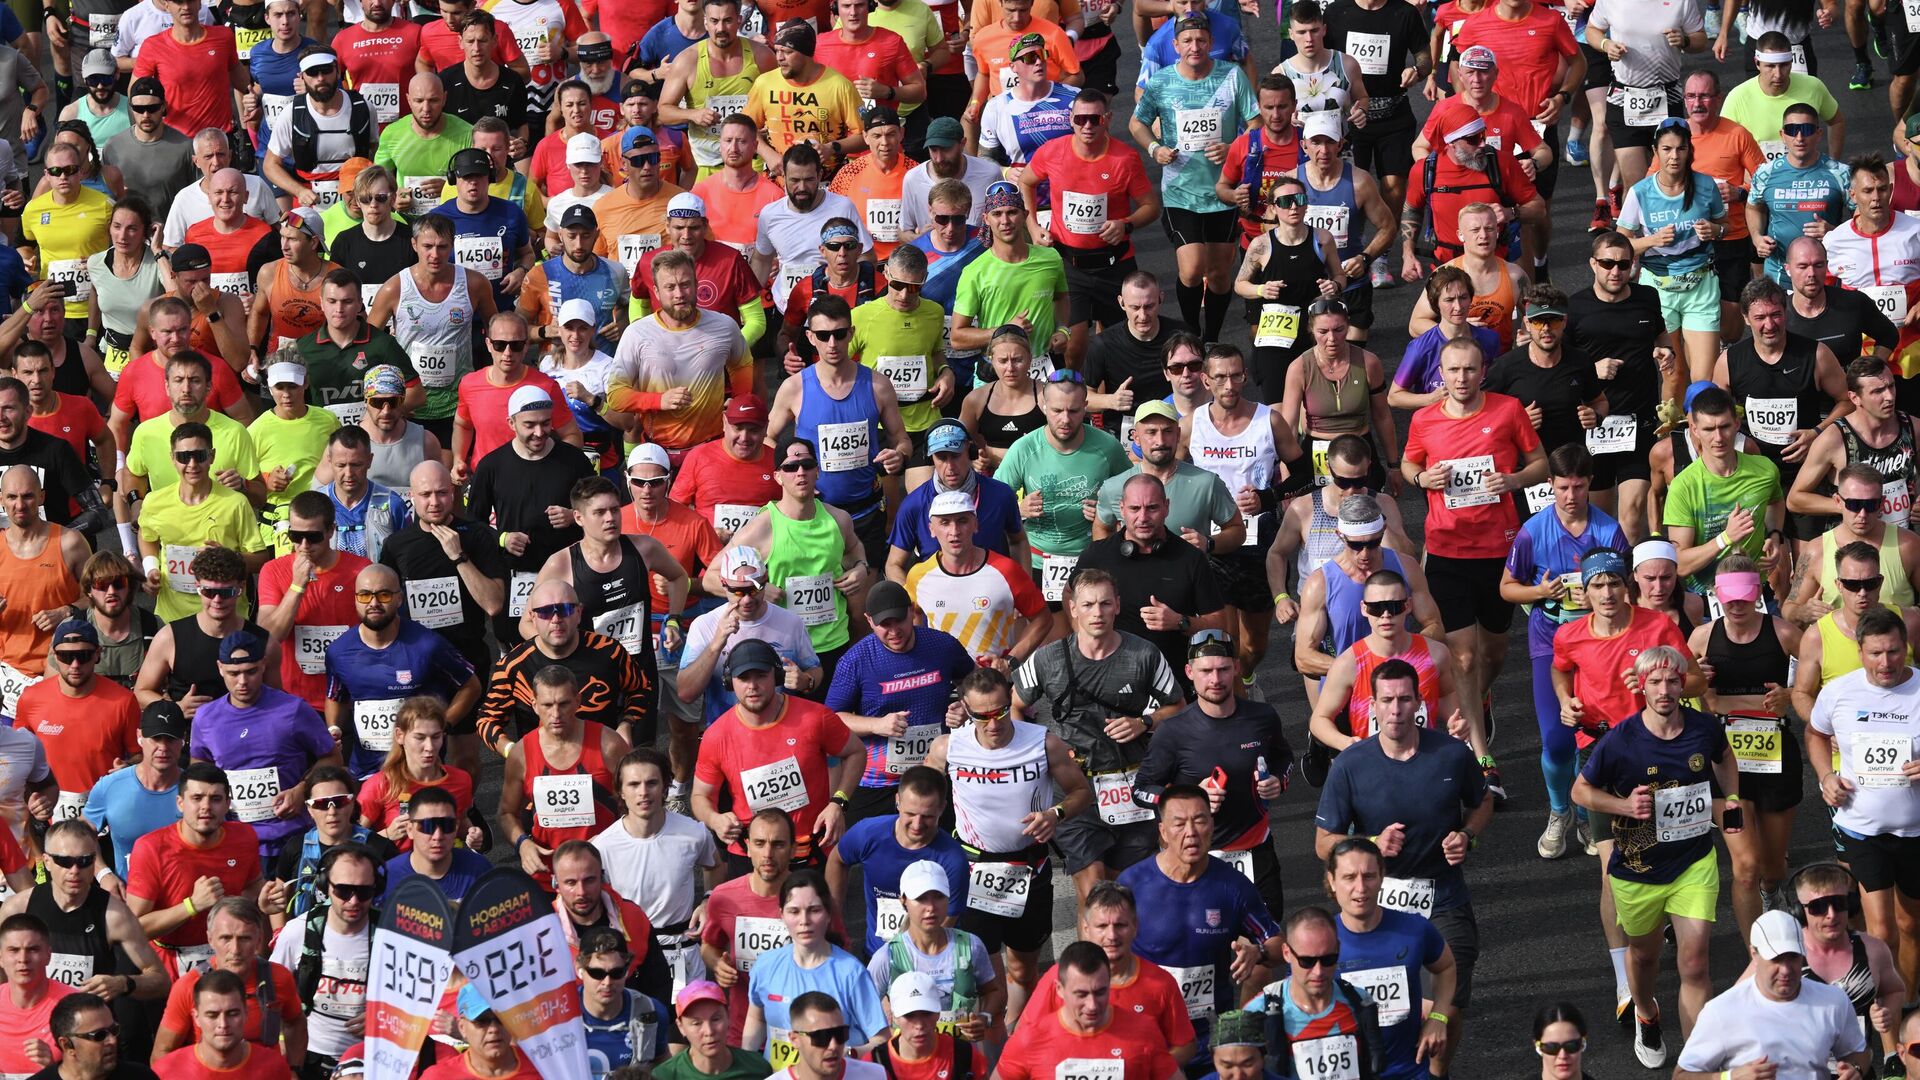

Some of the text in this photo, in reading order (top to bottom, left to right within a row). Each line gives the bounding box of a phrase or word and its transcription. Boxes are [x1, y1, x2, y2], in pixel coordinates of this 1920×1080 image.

[353, 37, 403, 50] FIESTROCO
[1352, 43, 1383, 57] 7691
[770, 90, 819, 106] LUKA
[1629, 96, 1662, 110] 8347
[794, 120, 834, 133] TRAIL
[1183, 119, 1217, 134] 4285
[1792, 180, 1830, 189] БЕГУ ЗА
[1774, 188, 1830, 200] СИБУР
[1068, 203, 1103, 218] 7692
[1650, 210, 1681, 223] БЕГУ
[457, 247, 501, 263] 14504
[1262, 315, 1293, 330] 2972
[419, 356, 446, 370] 506
[883, 368, 922, 383] 9457
[1749, 409, 1796, 425] 15087
[1589, 426, 1634, 439] 13147
[822, 433, 869, 452] 14854
[1203, 445, 1256, 459] РАКЕТЫ
[826, 462, 831, 470] F
[409, 590, 459, 609] 19206
[793, 586, 830, 605] 2700
[606, 617, 636, 639] 977
[885, 671, 940, 693] ПЛАНБЕГ
[1872, 711, 1909, 720] ТЭК-Торг
[1732, 733, 1776, 751] 5936
[1864, 747, 1898, 764] 639
[956, 762, 1041, 784] РАКЕТЫ
[747, 770, 802, 801] 12520
[546, 789, 580, 806] 833
[766, 792, 788, 802] МАКСИМ
[1663, 796, 1706, 820] 4760
[542, 818, 550, 826] G
[1109, 814, 1115, 823] G
[1662, 831, 1670, 840] G
[974, 870, 1028, 896] 18323
[970, 897, 976, 906] F
[1378, 887, 1432, 910] 16046
[396, 903, 443, 930] МАРАФОН
[396, 917, 435, 940] МОСКВА
[321, 1003, 328, 1011] G
[1305, 1051, 1351, 1076] 1695
